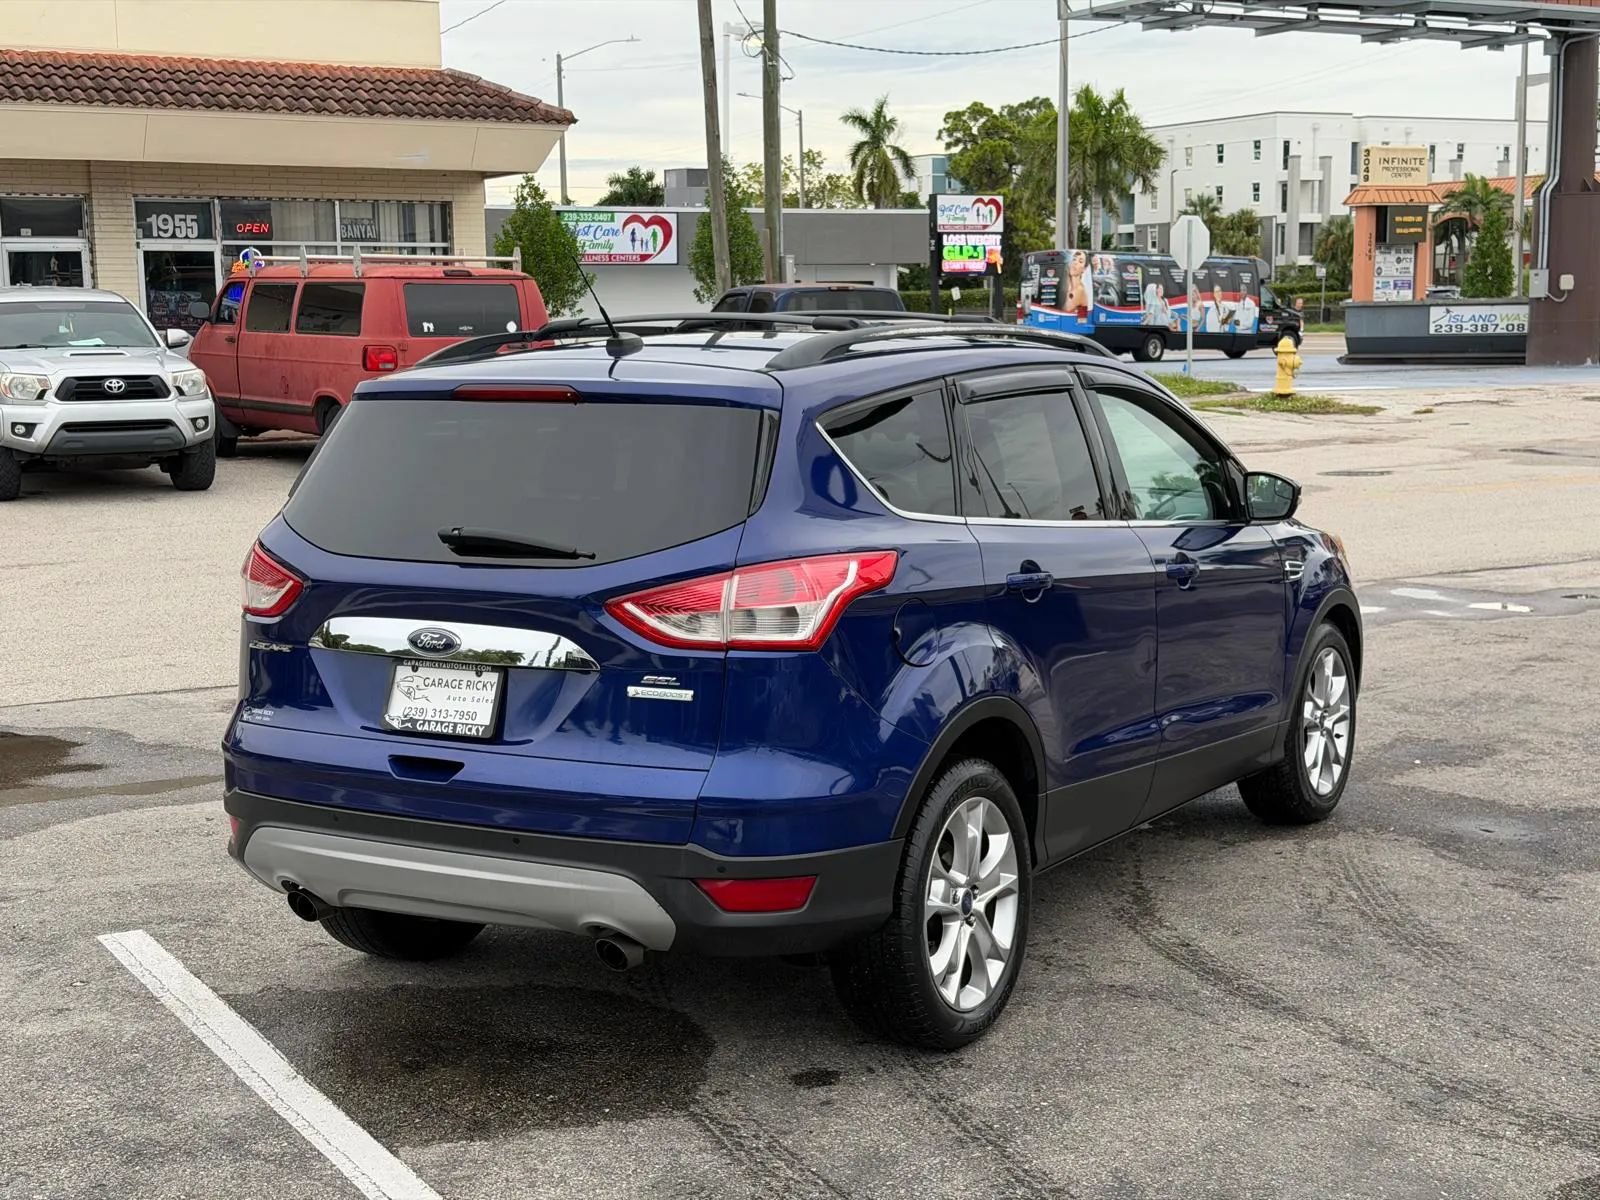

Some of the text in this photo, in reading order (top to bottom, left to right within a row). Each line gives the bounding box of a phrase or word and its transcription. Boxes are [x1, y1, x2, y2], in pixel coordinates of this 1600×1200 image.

[1378, 156, 1425, 166] INFINITE
[146, 214, 198, 239] 1955
[236, 223, 269, 233] OPEN
[340, 224, 377, 239] BANYAI
[593, 225, 620, 240] Care
[578, 239, 614, 253] Family
[1448, 314, 1497, 323] ISLAND
[1434, 323, 1526, 333] 239-387-08
[417, 632, 447, 649] Ford
[423, 677, 496, 692] GARAGE RICKY
[470, 696, 495, 704] Sales
[640, 689, 689, 699] ECOBOOST
[402, 706, 478, 722] (239) 313-7950
[416, 720, 485, 736] GARAGE RICKY
